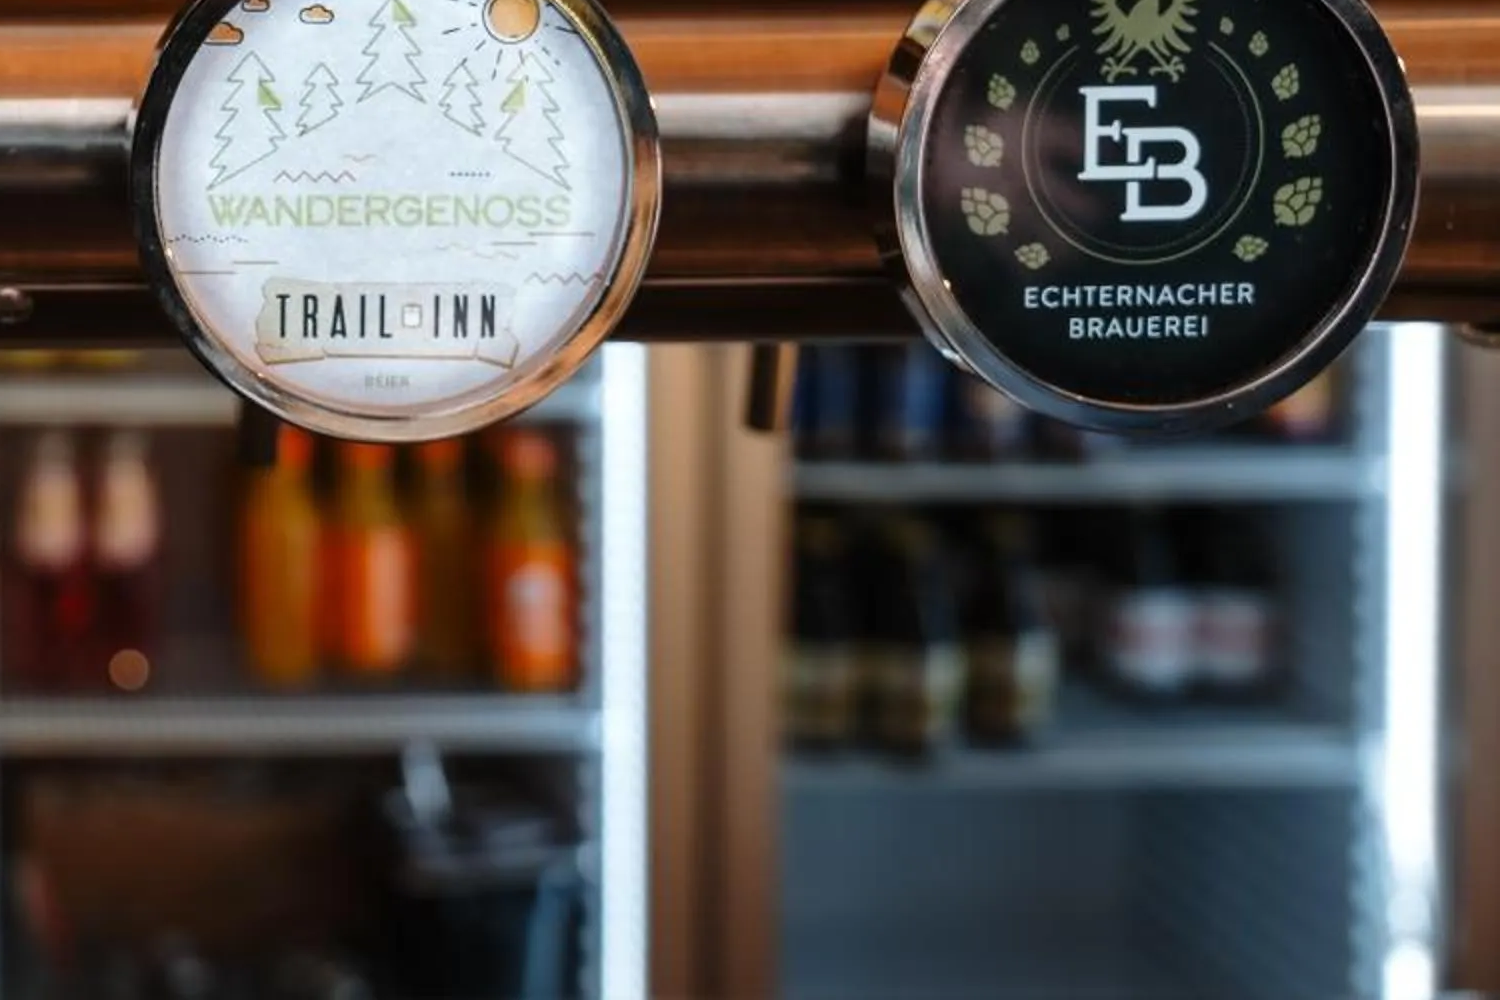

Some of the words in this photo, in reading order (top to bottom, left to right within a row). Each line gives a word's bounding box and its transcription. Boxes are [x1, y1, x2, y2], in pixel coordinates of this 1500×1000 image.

[208, 194, 572, 228] WANDERGENOSS
[1023, 282, 1255, 309] ECHTERNACHER
[276, 293, 393, 339] TRAIL
[433, 293, 497, 339] INN
[1068, 315, 1209, 340] BRAUEREI
